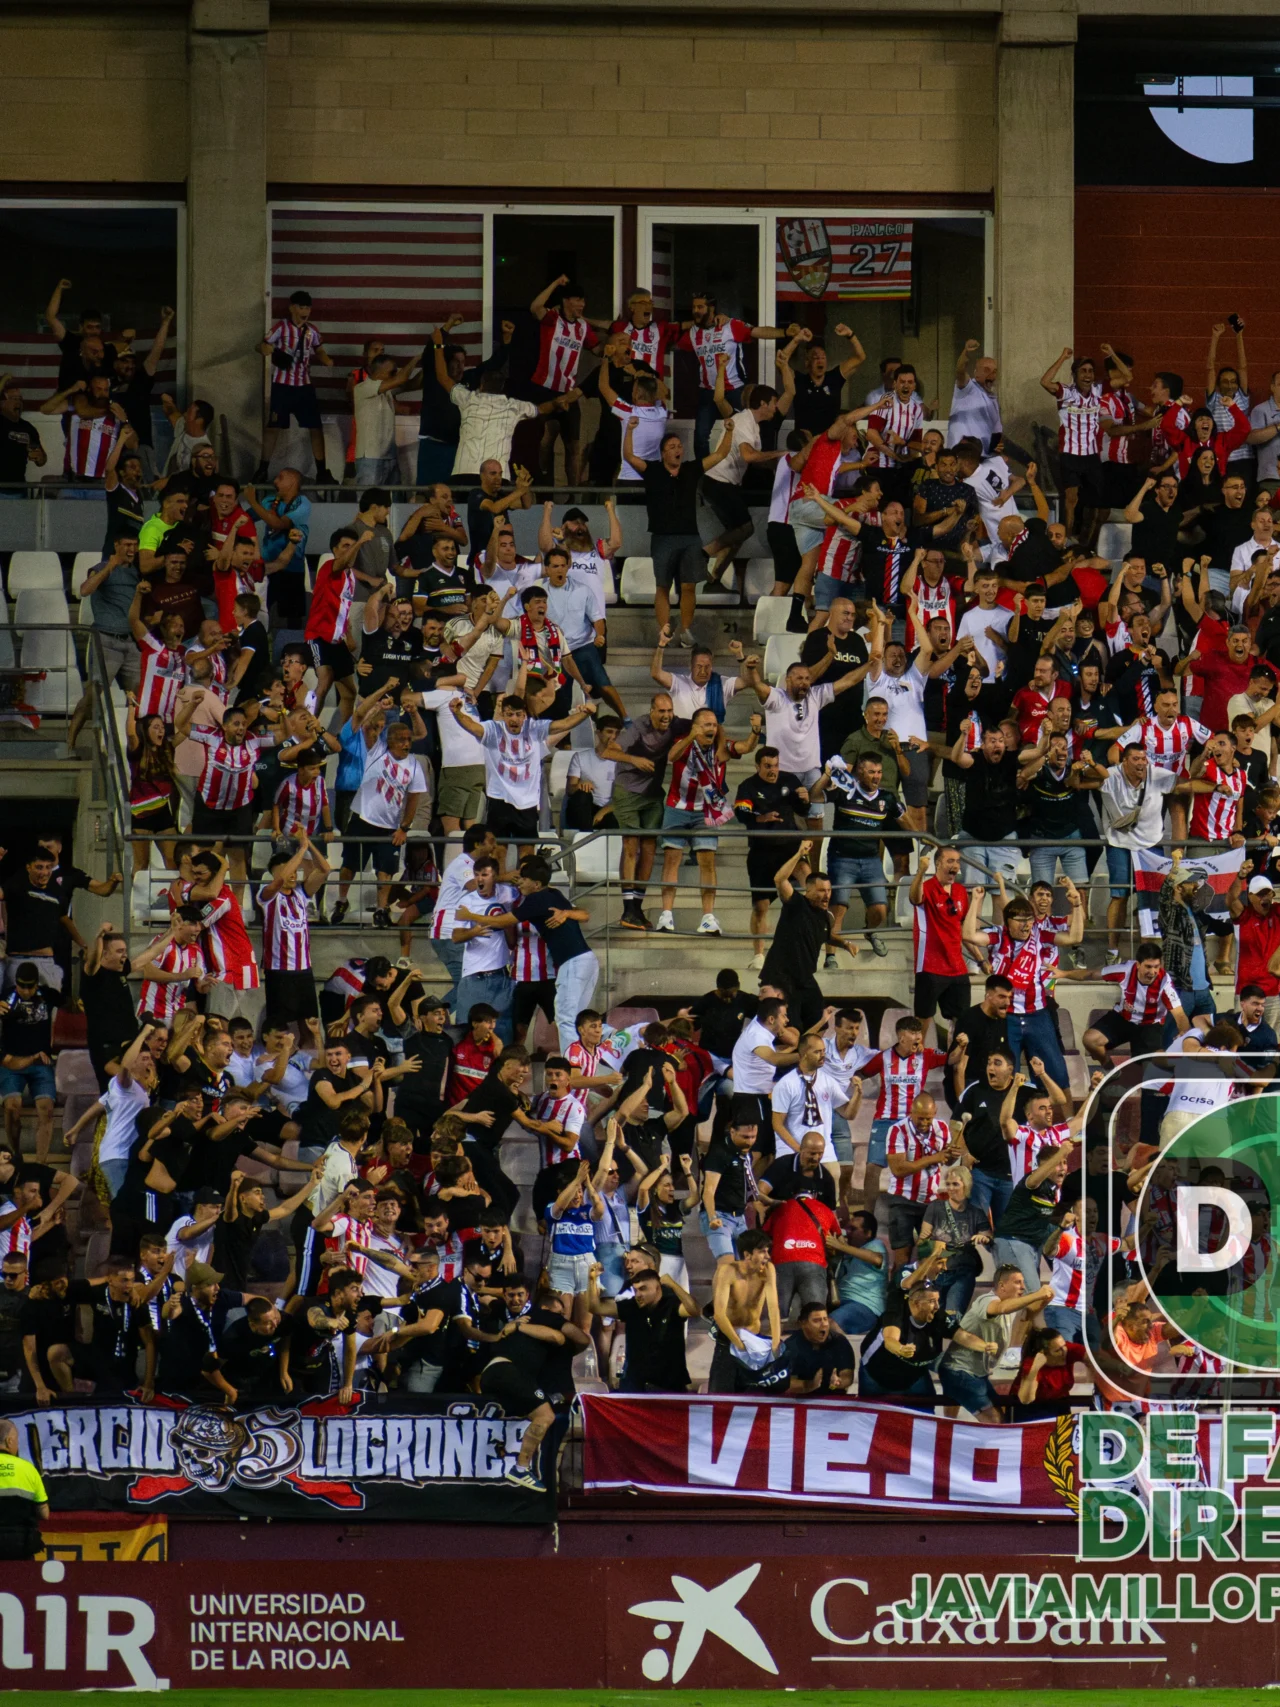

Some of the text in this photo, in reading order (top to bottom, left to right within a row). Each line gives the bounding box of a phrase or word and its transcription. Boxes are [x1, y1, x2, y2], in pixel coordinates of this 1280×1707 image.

[850, 223, 904, 236] PALCO
[850, 240, 902, 276] 27
[723, 622, 737, 633] 21
[833, 651, 860, 663] didas
[1180, 1094, 1214, 1105] ocisa
[10, 1408, 177, 1474] TERCIO
[688, 1405, 1023, 1505] VIEJO
[190, 1593, 365, 1615] UNIVERSIDAD
[811, 1577, 1166, 1646] CaixaBank
[190, 1621, 404, 1642] INTERNACIONAL
[191, 1649, 350, 1671] DE LA RIOJA
